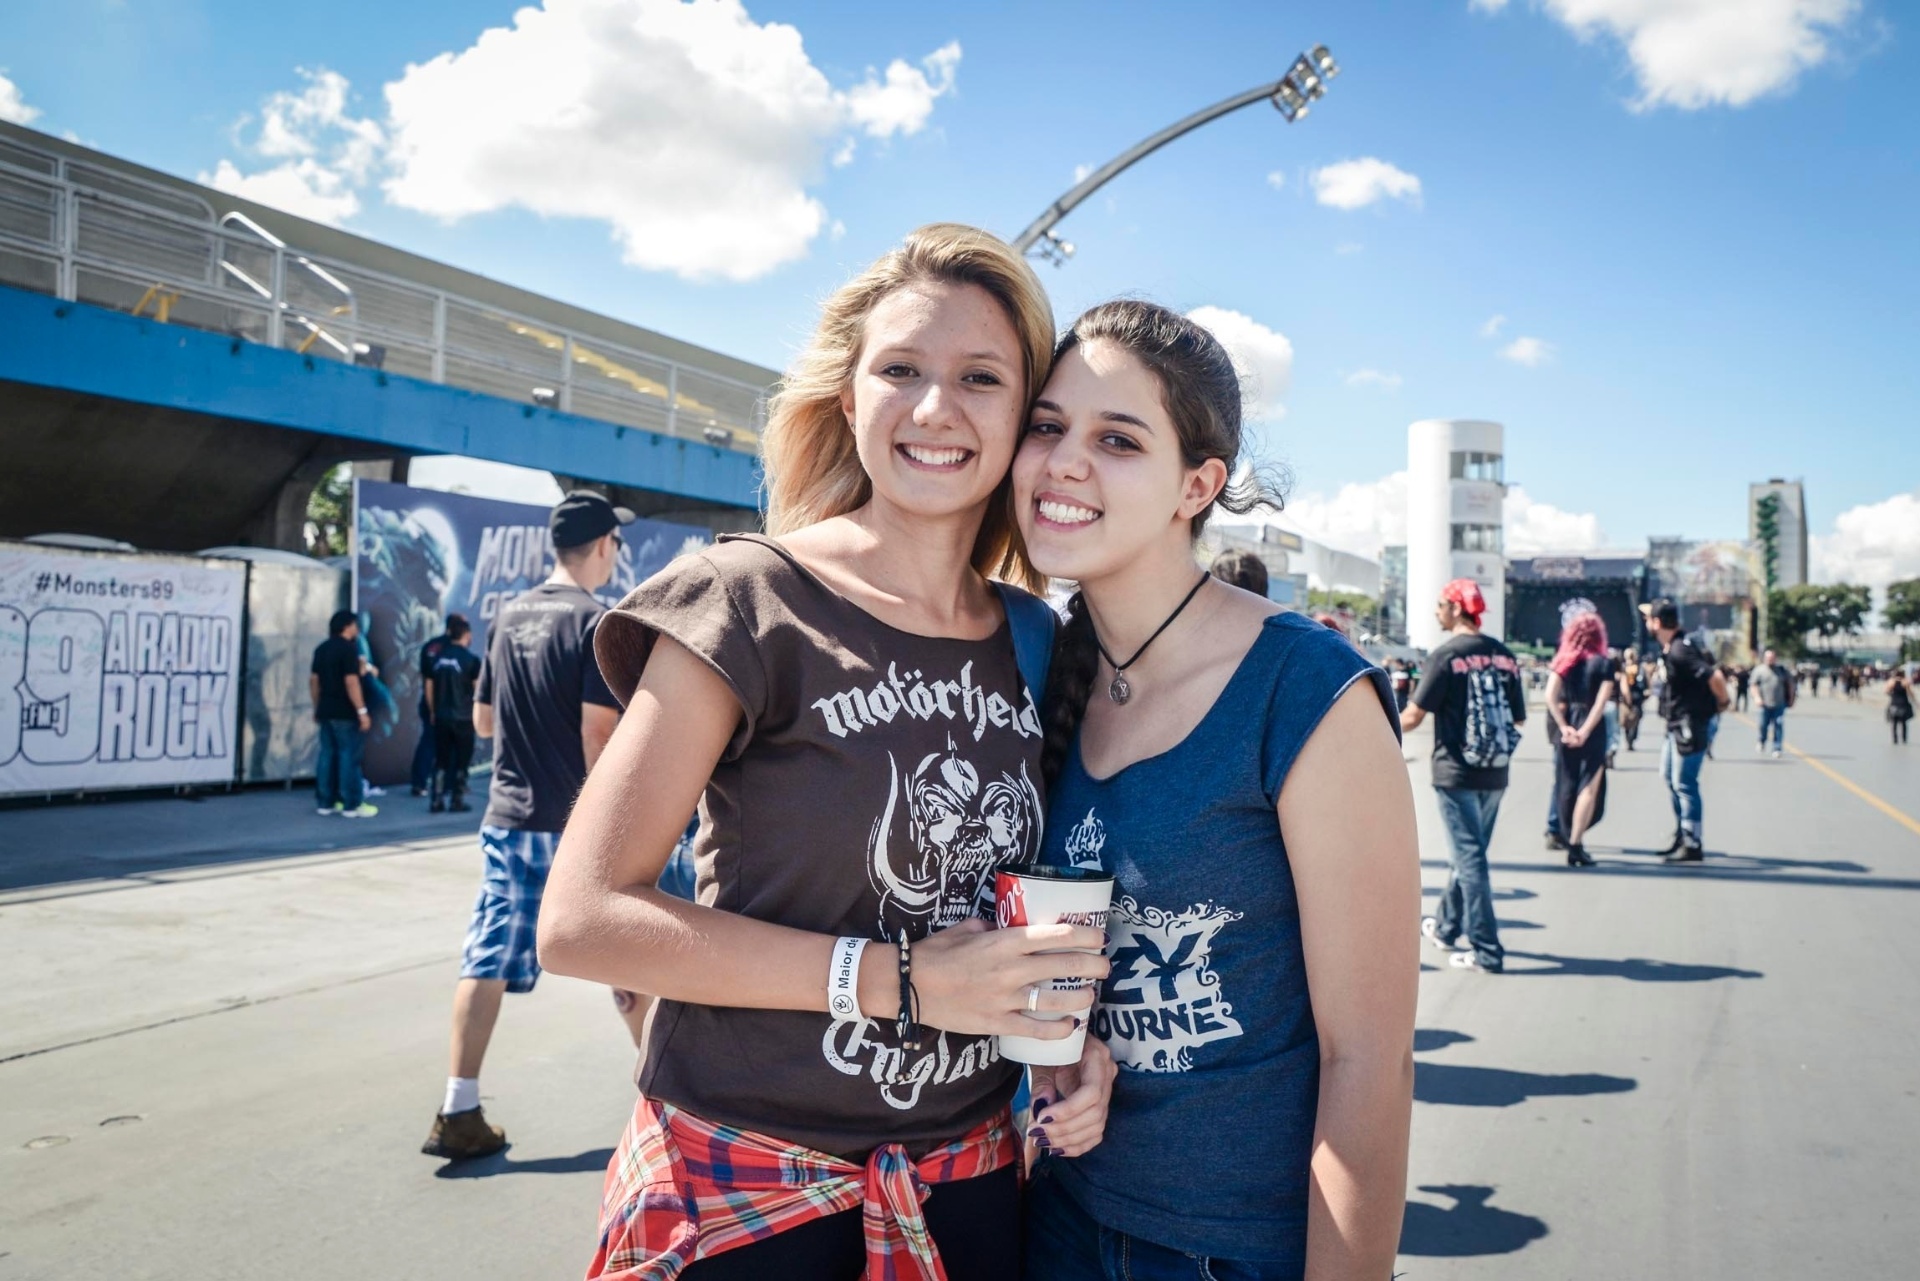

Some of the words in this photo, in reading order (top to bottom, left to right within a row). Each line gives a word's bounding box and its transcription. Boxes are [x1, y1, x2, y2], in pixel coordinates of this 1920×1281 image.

[36, 573, 174, 599] #Monsters89
[104, 610, 130, 674] A
[134, 611, 232, 674] RADIO
[97, 673, 229, 763] ROCK
[838, 951, 853, 989] Maior
[1098, 931, 1205, 1004] ZY
[1089, 996, 1229, 1042] OURNE
[822, 1017, 1000, 1110] Englan
